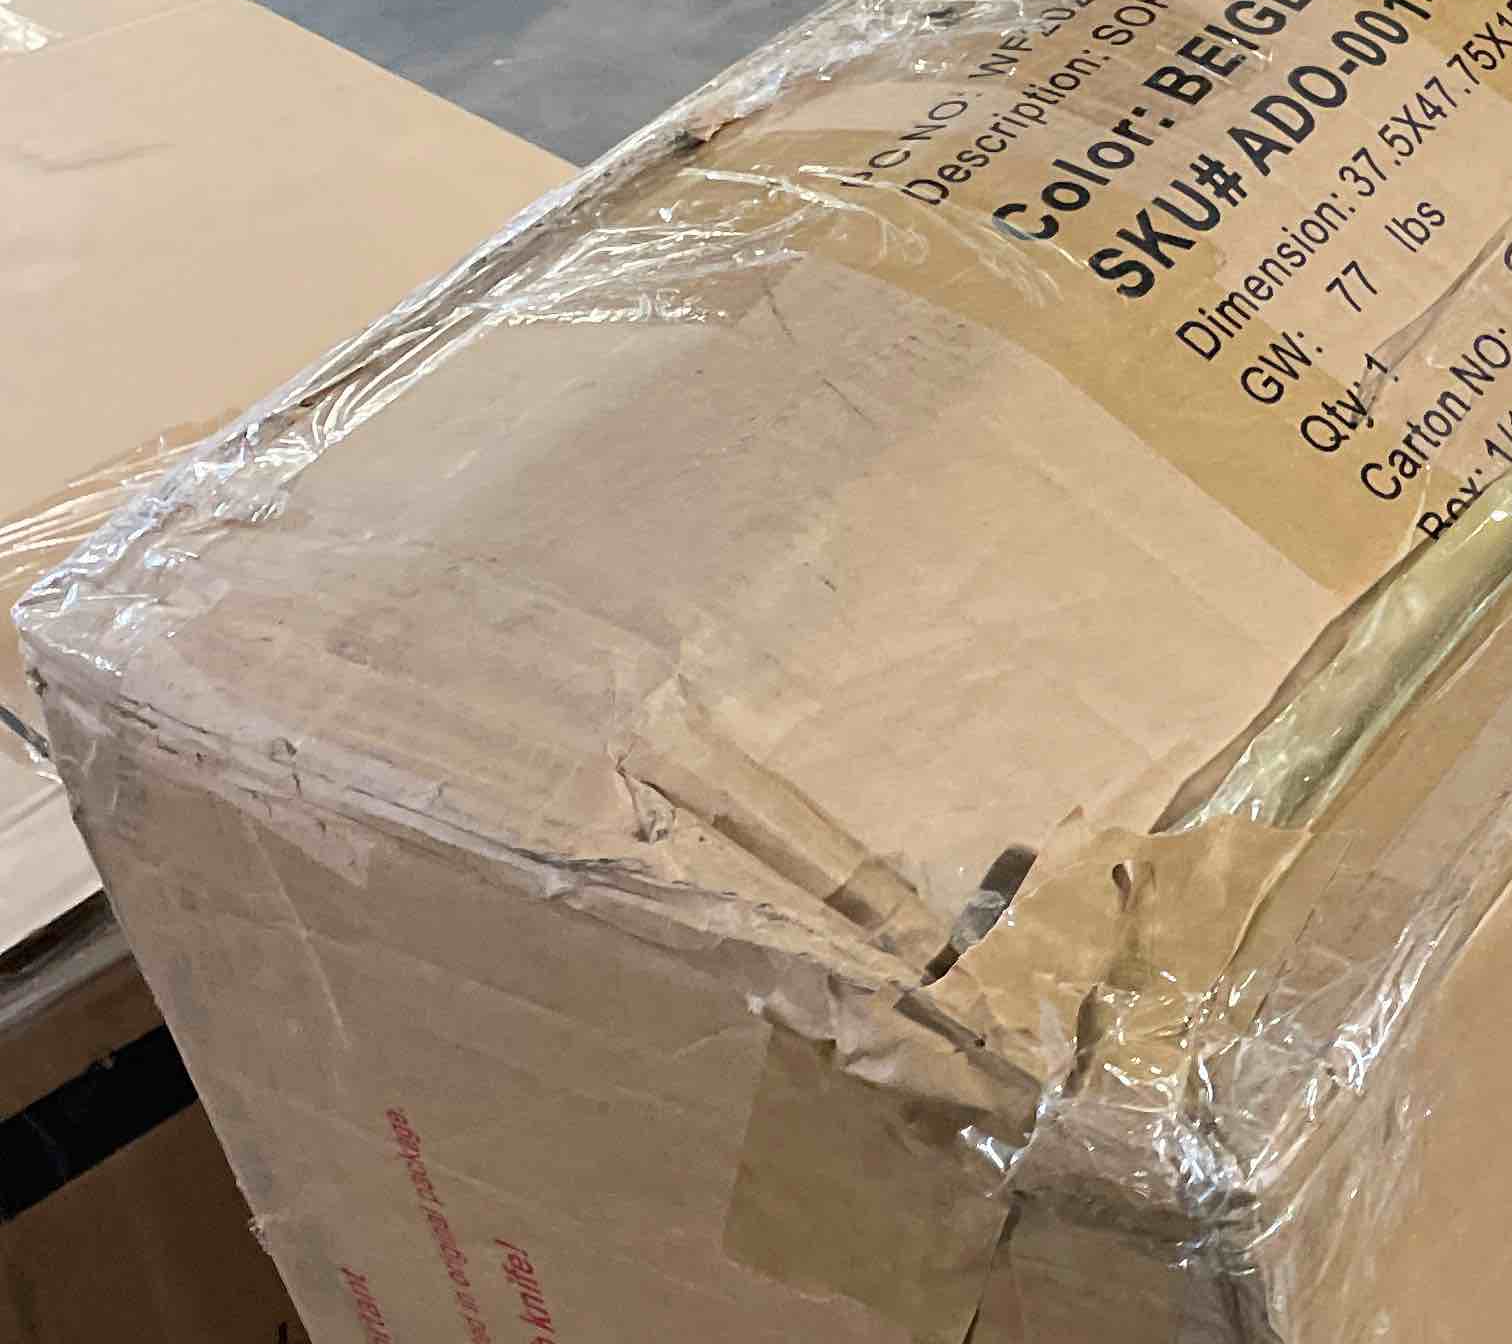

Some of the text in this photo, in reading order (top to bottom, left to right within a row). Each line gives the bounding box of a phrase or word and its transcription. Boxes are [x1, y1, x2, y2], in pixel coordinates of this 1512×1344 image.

[900, 49, 1110, 205] Description:
[992, 106, 1175, 241] Color:
[1176, 193, 1356, 361] Dimension:
[1240, 201, 1446, 405] GW: 77 lbs
[1361, 391, 1471, 500] Carton
[494, 1238, 555, 1334] knife!
